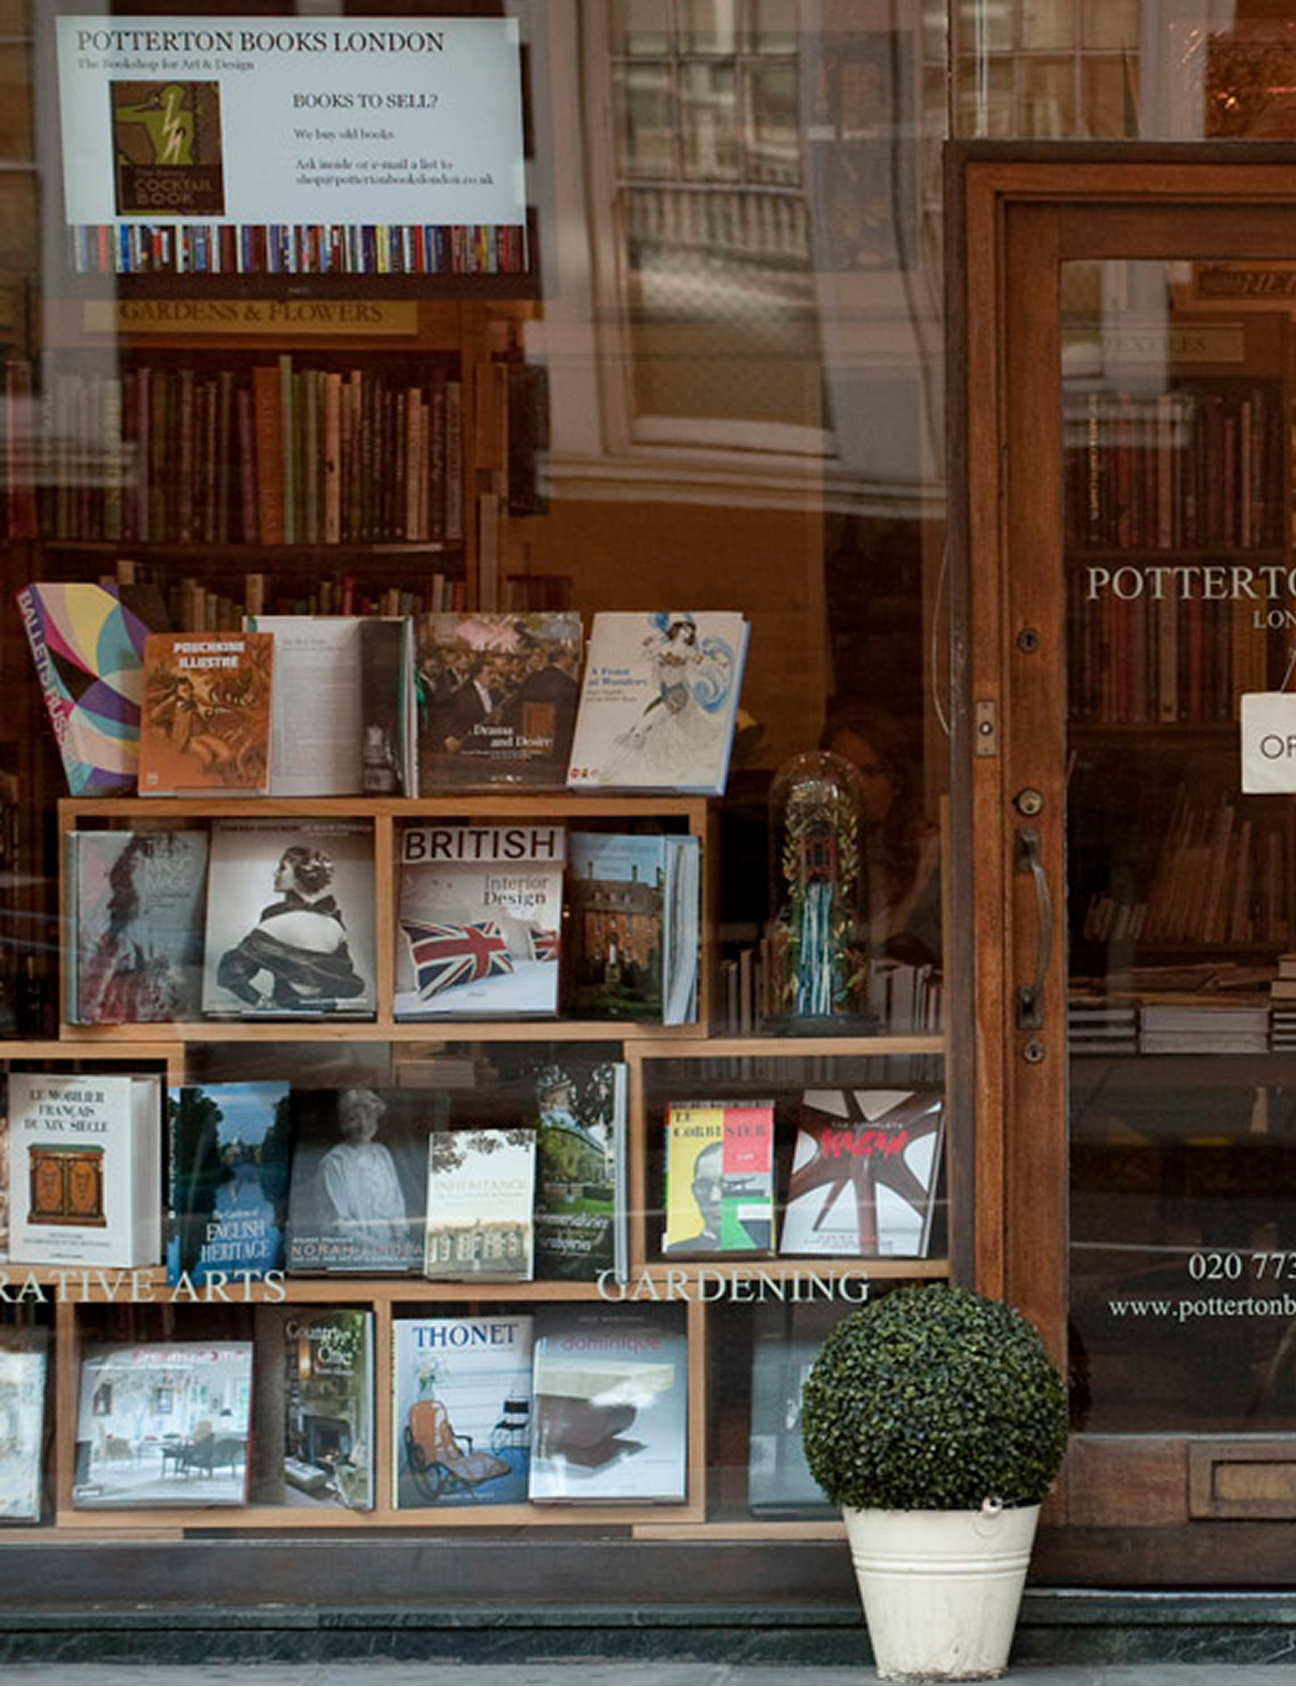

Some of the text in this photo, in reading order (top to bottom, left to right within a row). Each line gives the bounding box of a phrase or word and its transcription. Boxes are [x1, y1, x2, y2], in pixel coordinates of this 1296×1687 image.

[78, 31, 444, 52] POTTERTON BOOKS LONDON
[78, 57, 255, 72] The Bookshop for Art & Design
[293, 93, 439, 109] BOOKS TO SELL?
[294, 129, 394, 142] We buy old books
[296, 158, 316, 169] Ask
[319, 158, 351, 169] inside
[119, 302, 384, 323] GARDENS & FLOWERS
[405, 830, 555, 860] BRITISH
[484, 874, 549, 891] Interior
[483, 890, 547, 907] Design
[38, 1104, 95, 1121] FRANÇAIS
[206, 1220, 266, 1242] ENGLISH
[201, 1239, 271, 1264] HERITAGE
[1188, 1252, 1241, 1280] 020
[171, 1268, 287, 1303] ARTS
[596, 1269, 871, 1303] GARDENING
[412, 1323, 519, 1348] THONET
[563, 1335, 659, 1354] dominique
